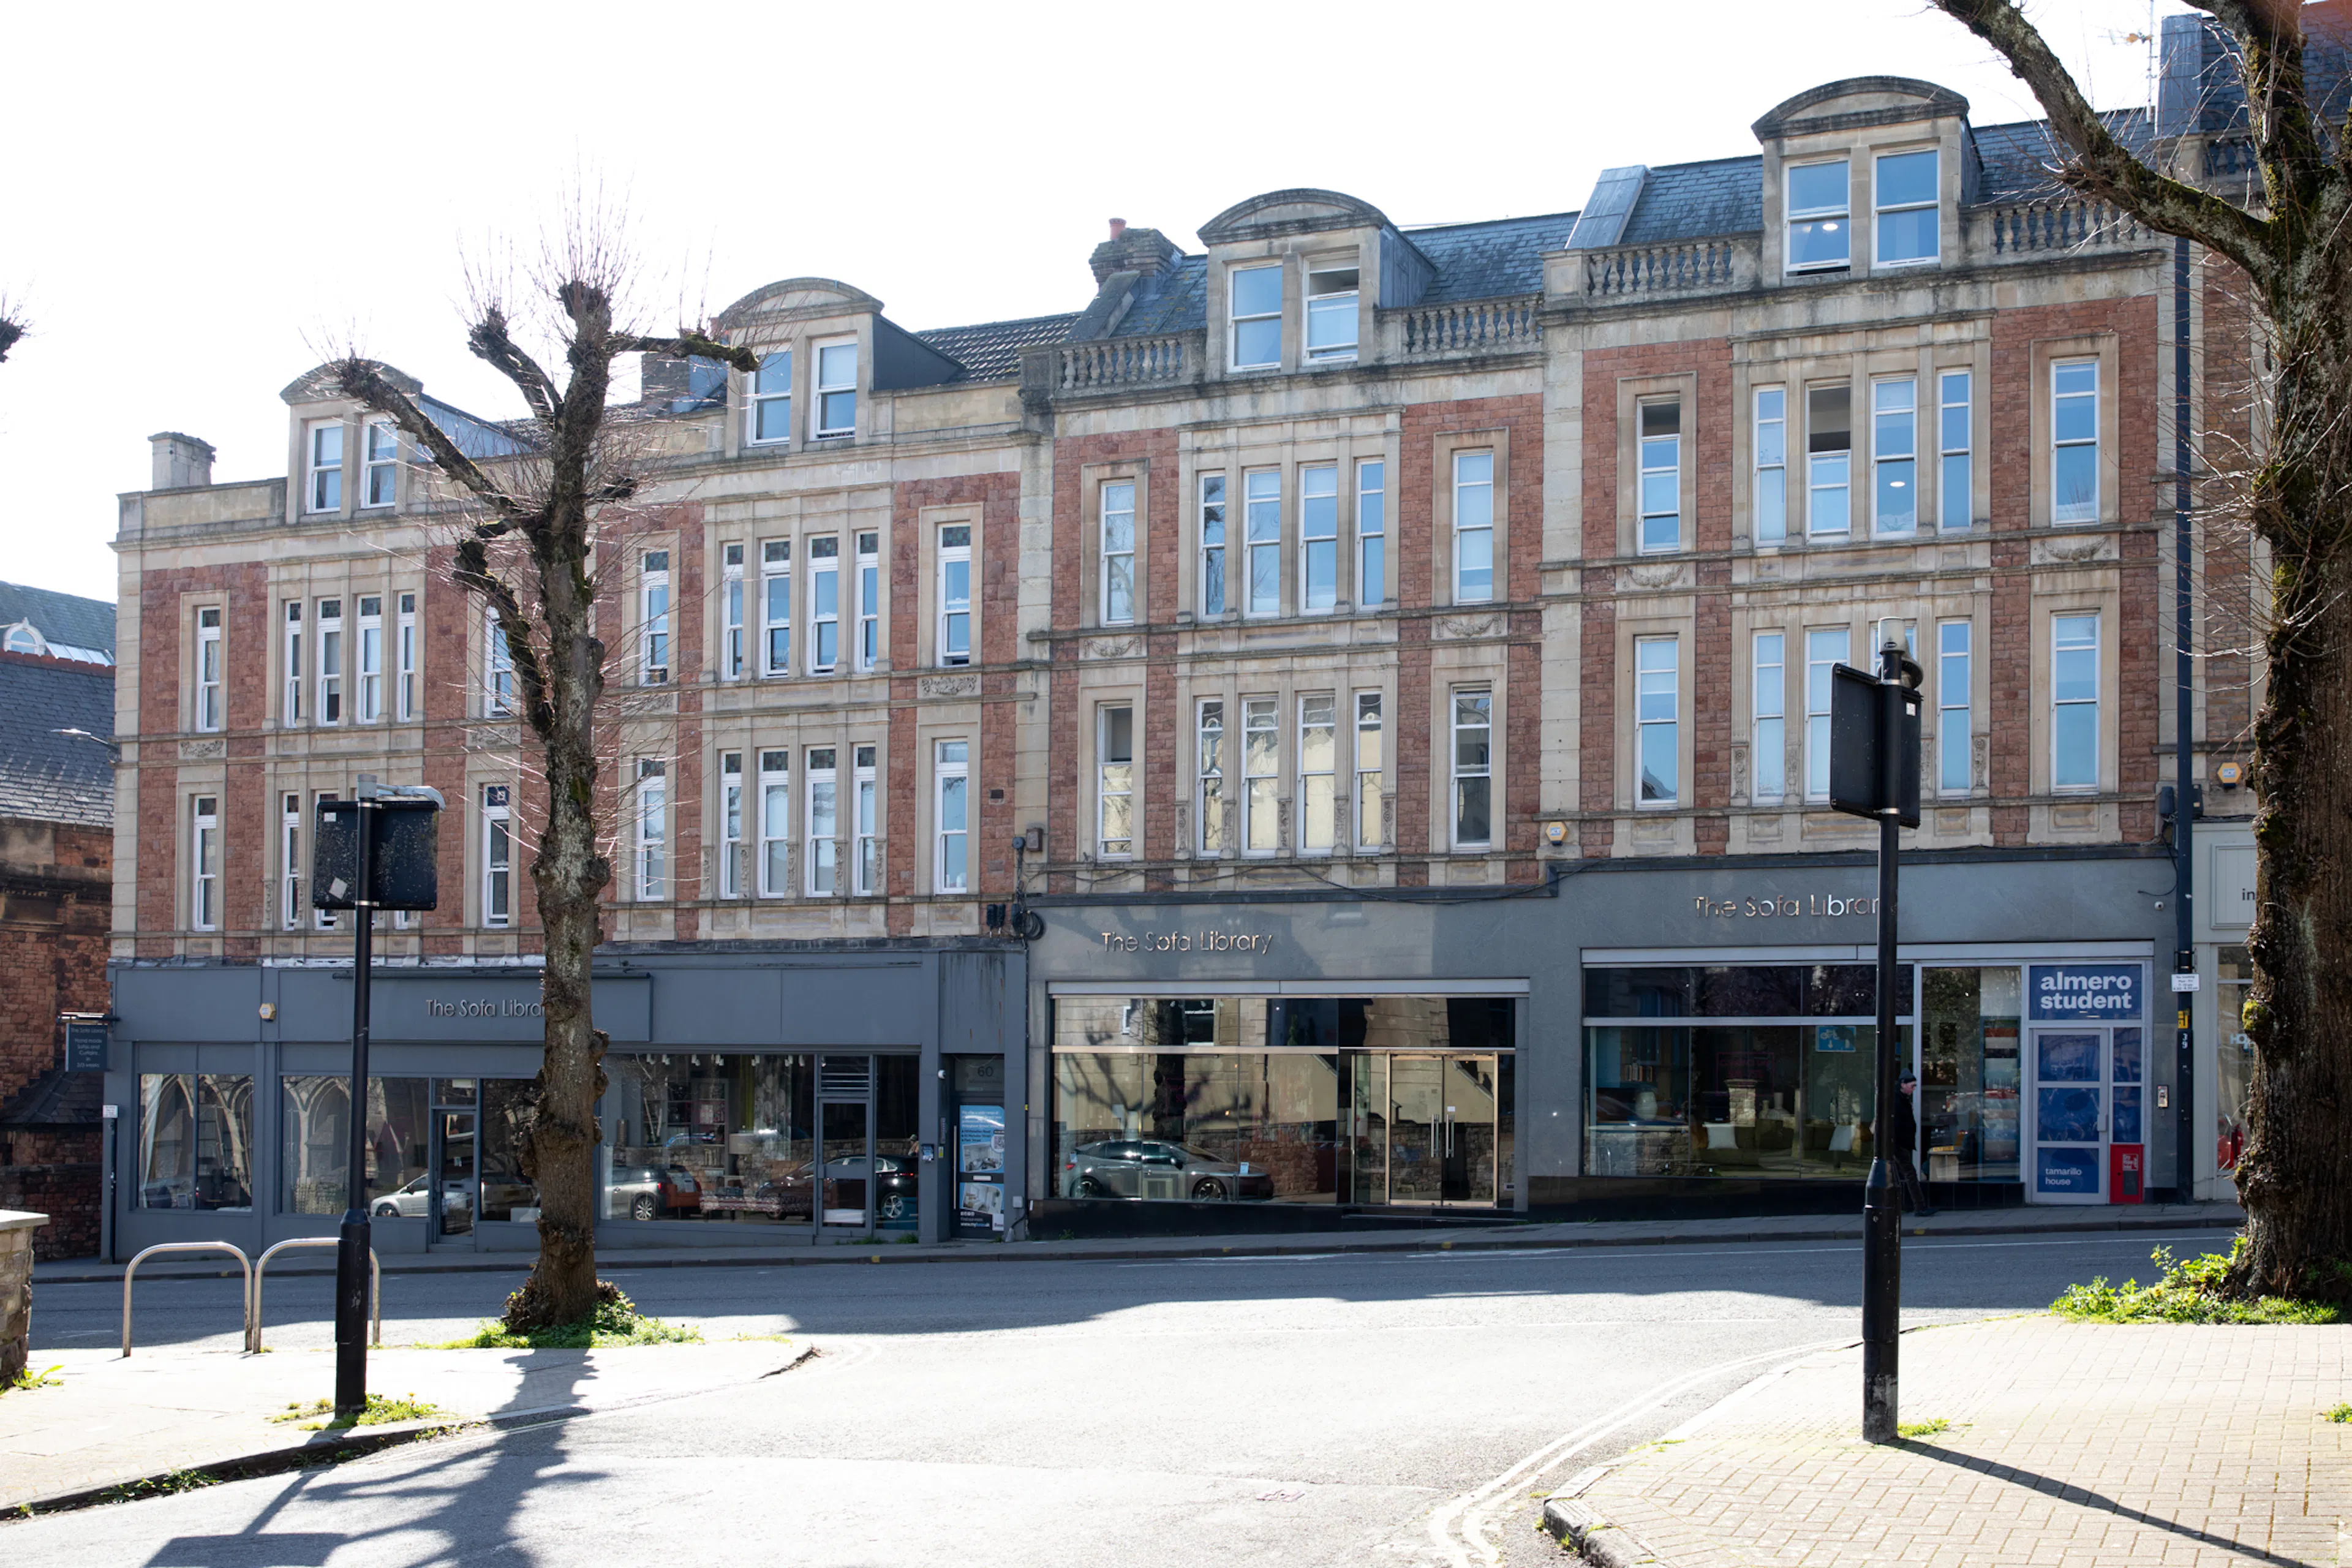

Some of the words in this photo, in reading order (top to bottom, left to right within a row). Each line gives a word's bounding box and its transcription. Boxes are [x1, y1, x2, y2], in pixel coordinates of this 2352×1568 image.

[1693, 896, 1736, 917] The
[1744, 895, 1800, 917] Sofa
[1811, 894, 1879, 916] Librar
[1102, 932, 1139, 951] The
[1145, 931, 1192, 951] Sofa
[1200, 930, 1272, 955] Library
[2040, 971, 2132, 990] almero
[426, 999, 455, 1017] The
[459, 998, 497, 1017] Sofa
[2040, 991, 2132, 1009] student
[978, 1066, 993, 1077] 60
[2045, 1177, 2071, 1185] house
